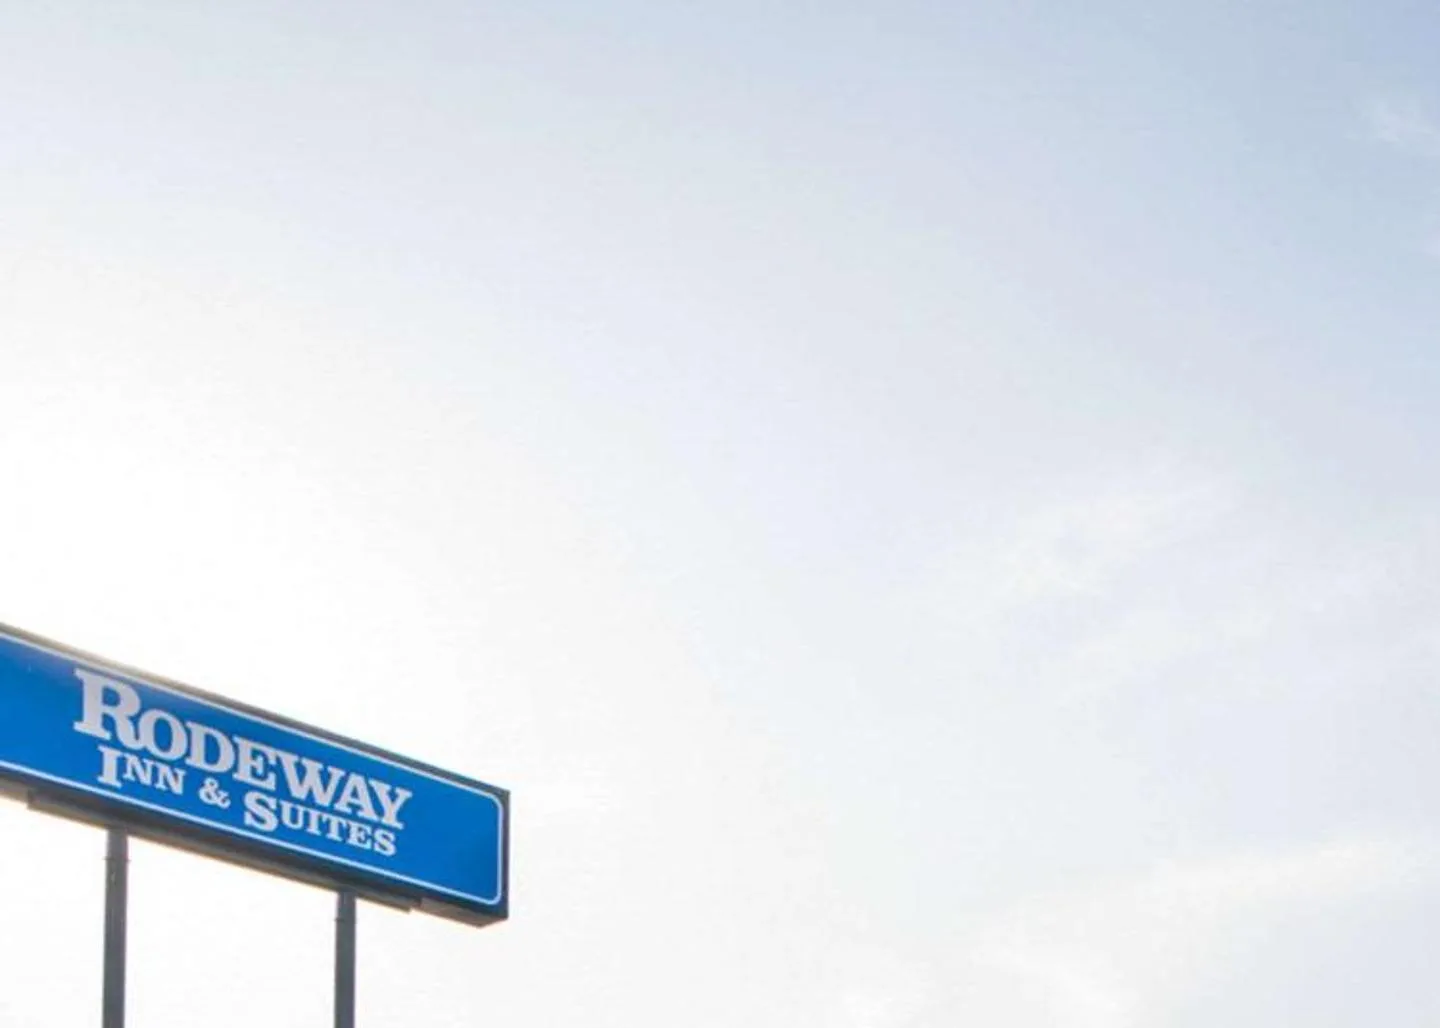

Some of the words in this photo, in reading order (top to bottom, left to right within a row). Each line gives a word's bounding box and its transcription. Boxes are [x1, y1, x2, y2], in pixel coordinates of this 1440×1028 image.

[74, 668, 412, 829] RODEWAY
[98, 746, 186, 795] INN
[199, 777, 230, 809] &
[244, 791, 397, 856] SUITES
